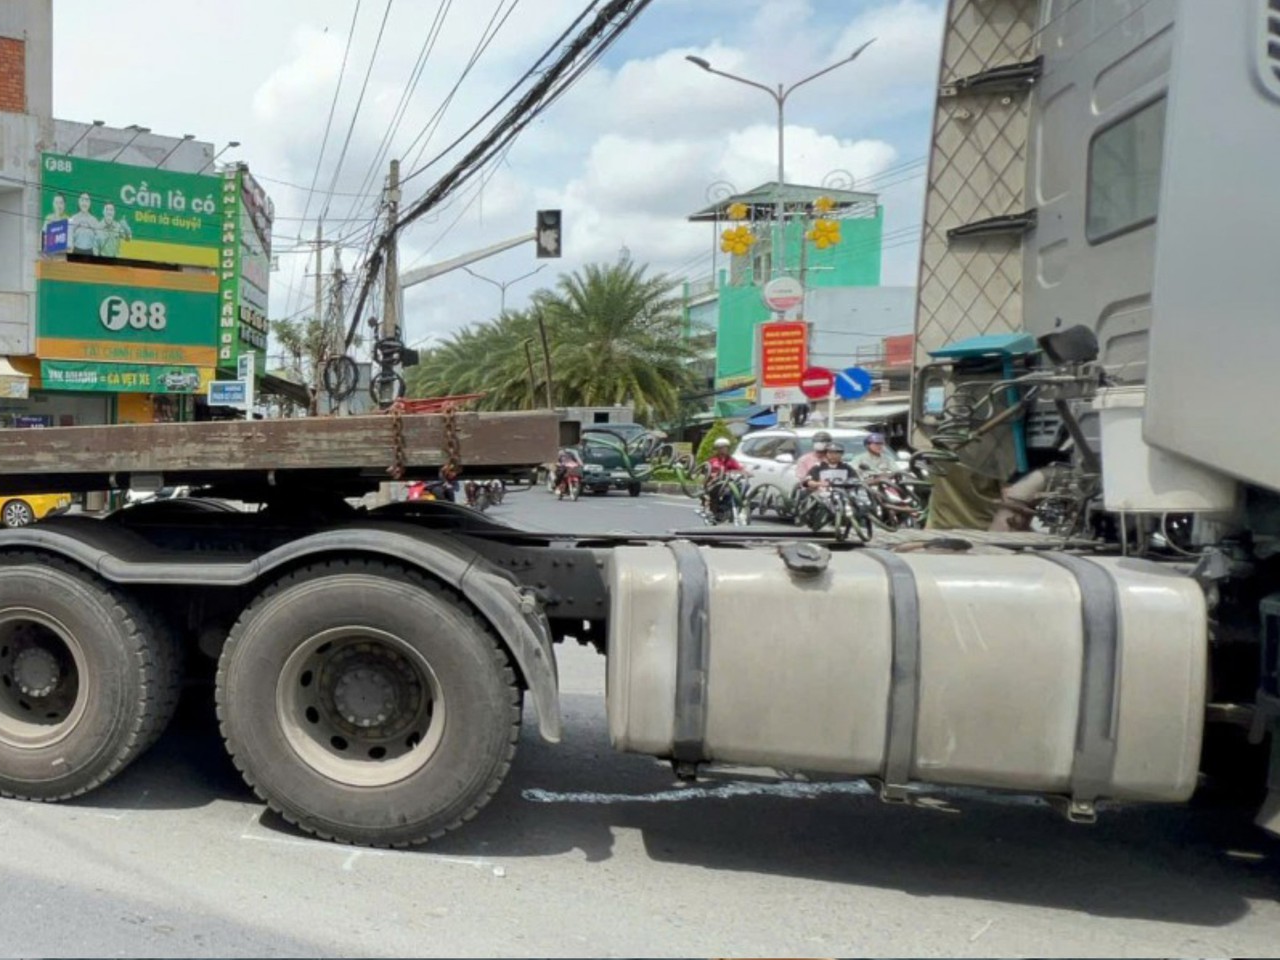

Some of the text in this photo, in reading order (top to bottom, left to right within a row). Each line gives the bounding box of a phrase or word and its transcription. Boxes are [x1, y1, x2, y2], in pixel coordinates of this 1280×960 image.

[45, 157, 72, 172] F88
[120, 181, 161, 208] Cần
[168, 189, 185, 210] là
[135, 209, 156, 223] Đến
[99, 295, 167, 331] F88
